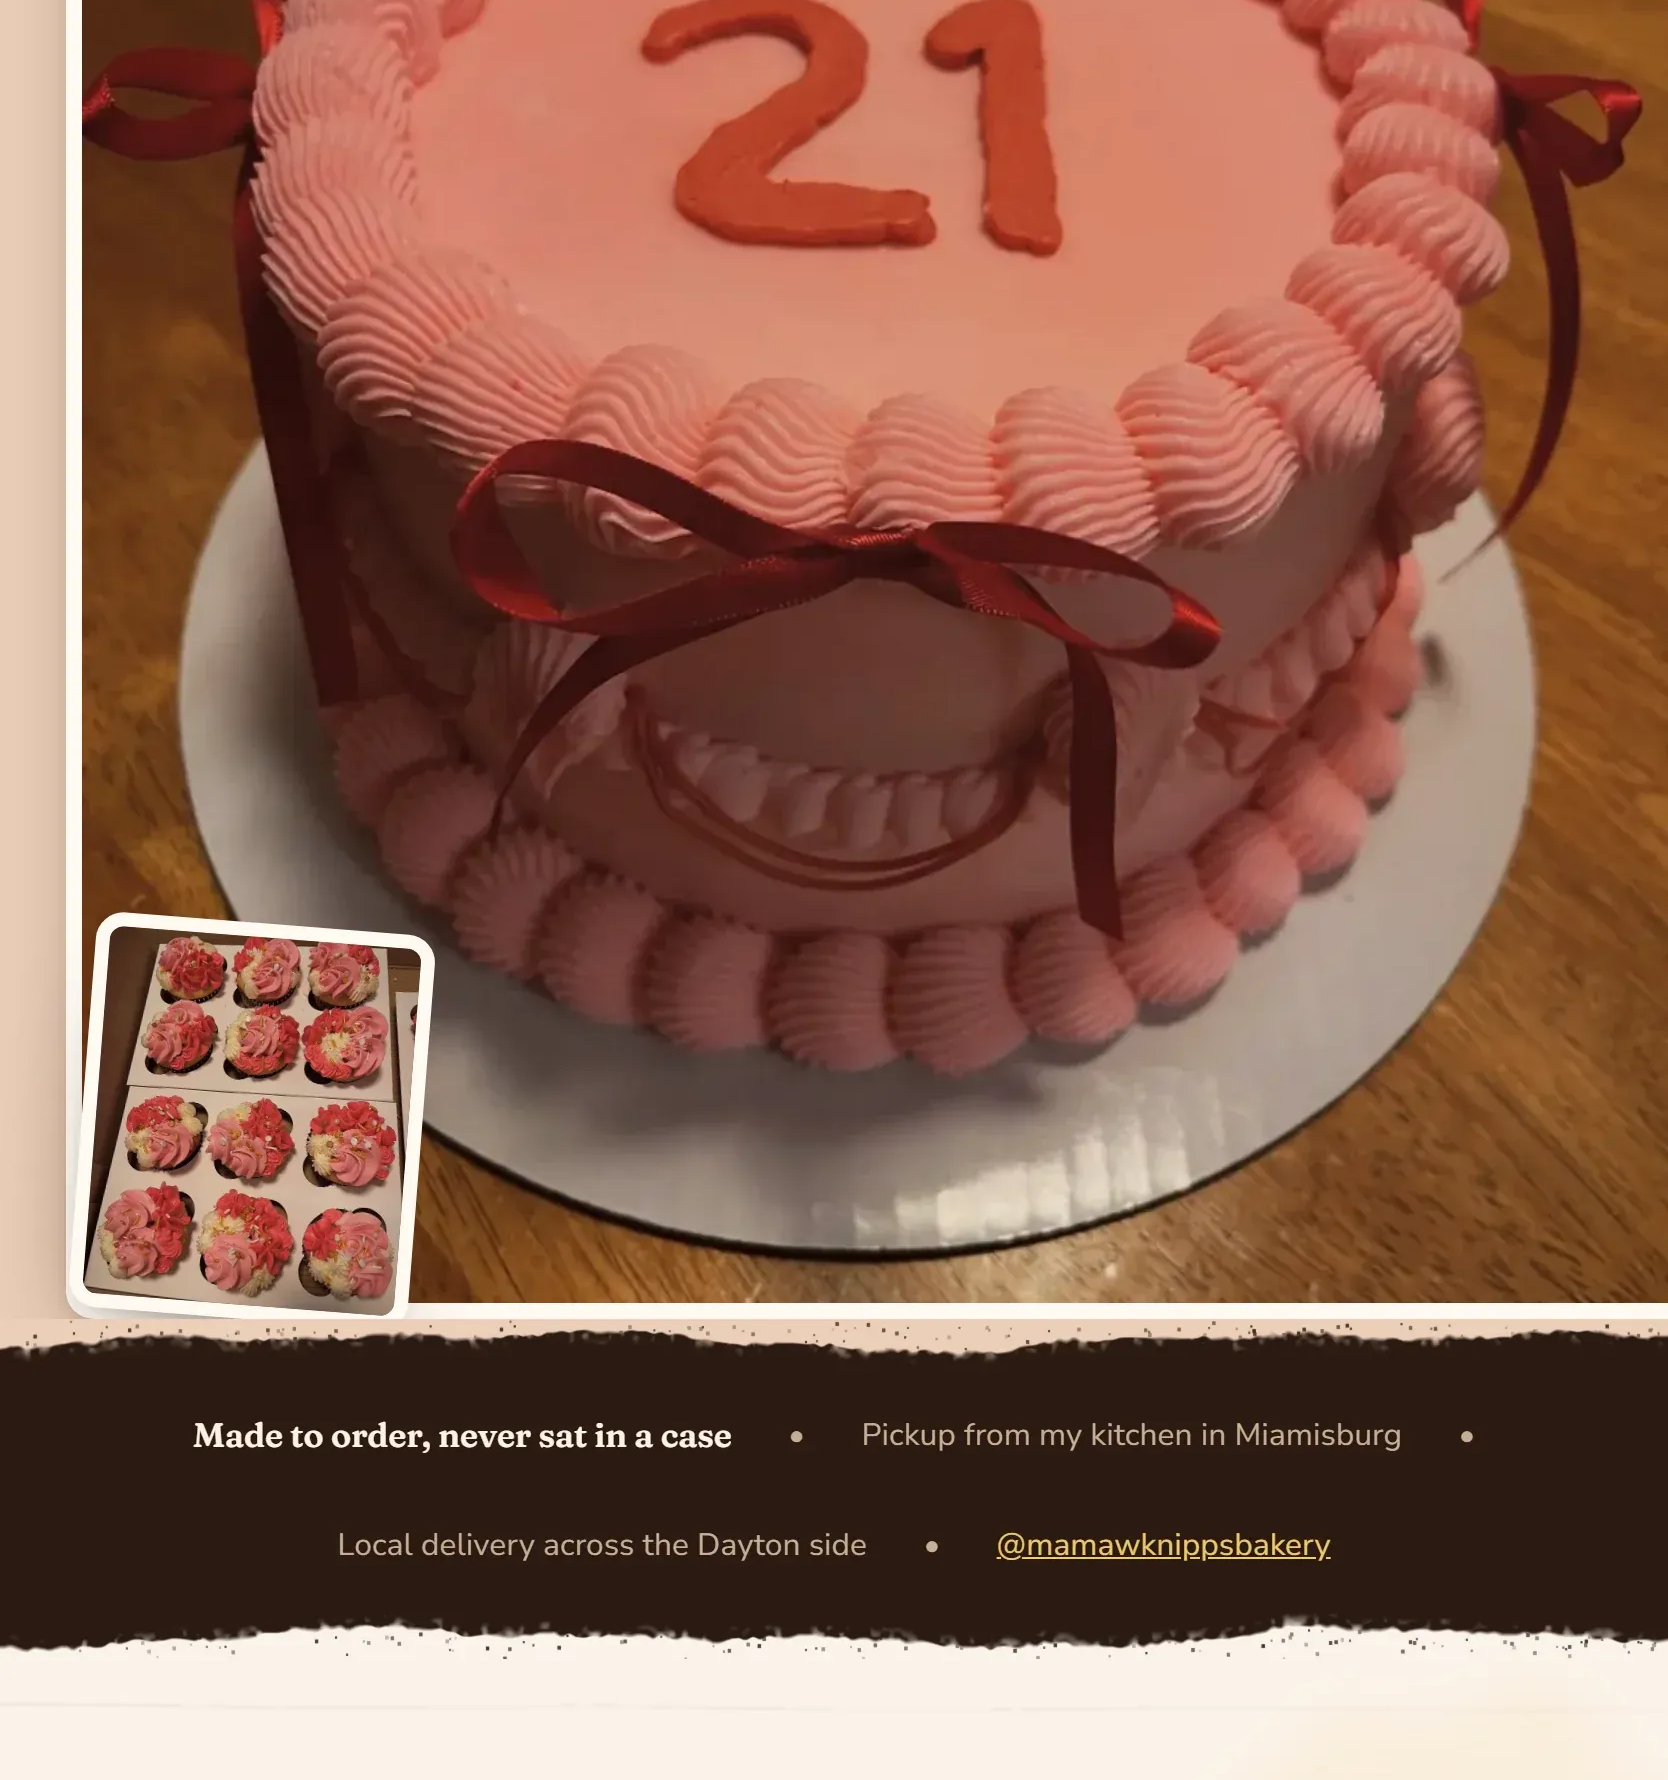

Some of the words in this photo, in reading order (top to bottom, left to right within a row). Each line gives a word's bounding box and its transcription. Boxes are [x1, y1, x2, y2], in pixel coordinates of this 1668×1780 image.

[192, 1420, 283, 1449] Made
[289, 1426, 324, 1449] to
[331, 1420, 431, 1454] order,
[438, 1429, 532, 1449] never
[538, 1425, 588, 1449] sat
[594, 1422, 628, 1448] in
[634, 1429, 654, 1449] a
[660, 1429, 732, 1449] case
[863, 1422, 956, 1452] Pickup
[963, 1422, 1030, 1446] from
[1040, 1428, 1083, 1452] my
[1091, 1422, 1192, 1446] kitchen
[1202, 1422, 1225, 1446] in
[1236, 1422, 1401, 1452] Miamisburg
[339, 1532, 414, 1556] Local
[421, 1532, 536, 1562] delivery
[544, 1538, 634, 1556] across
[641, 1532, 689, 1556] the
[698, 1532, 800, 1562] Dayton
[809, 1532, 867, 1556] side
[997, 1532, 1332, 1562] @mamawknippsbakery
